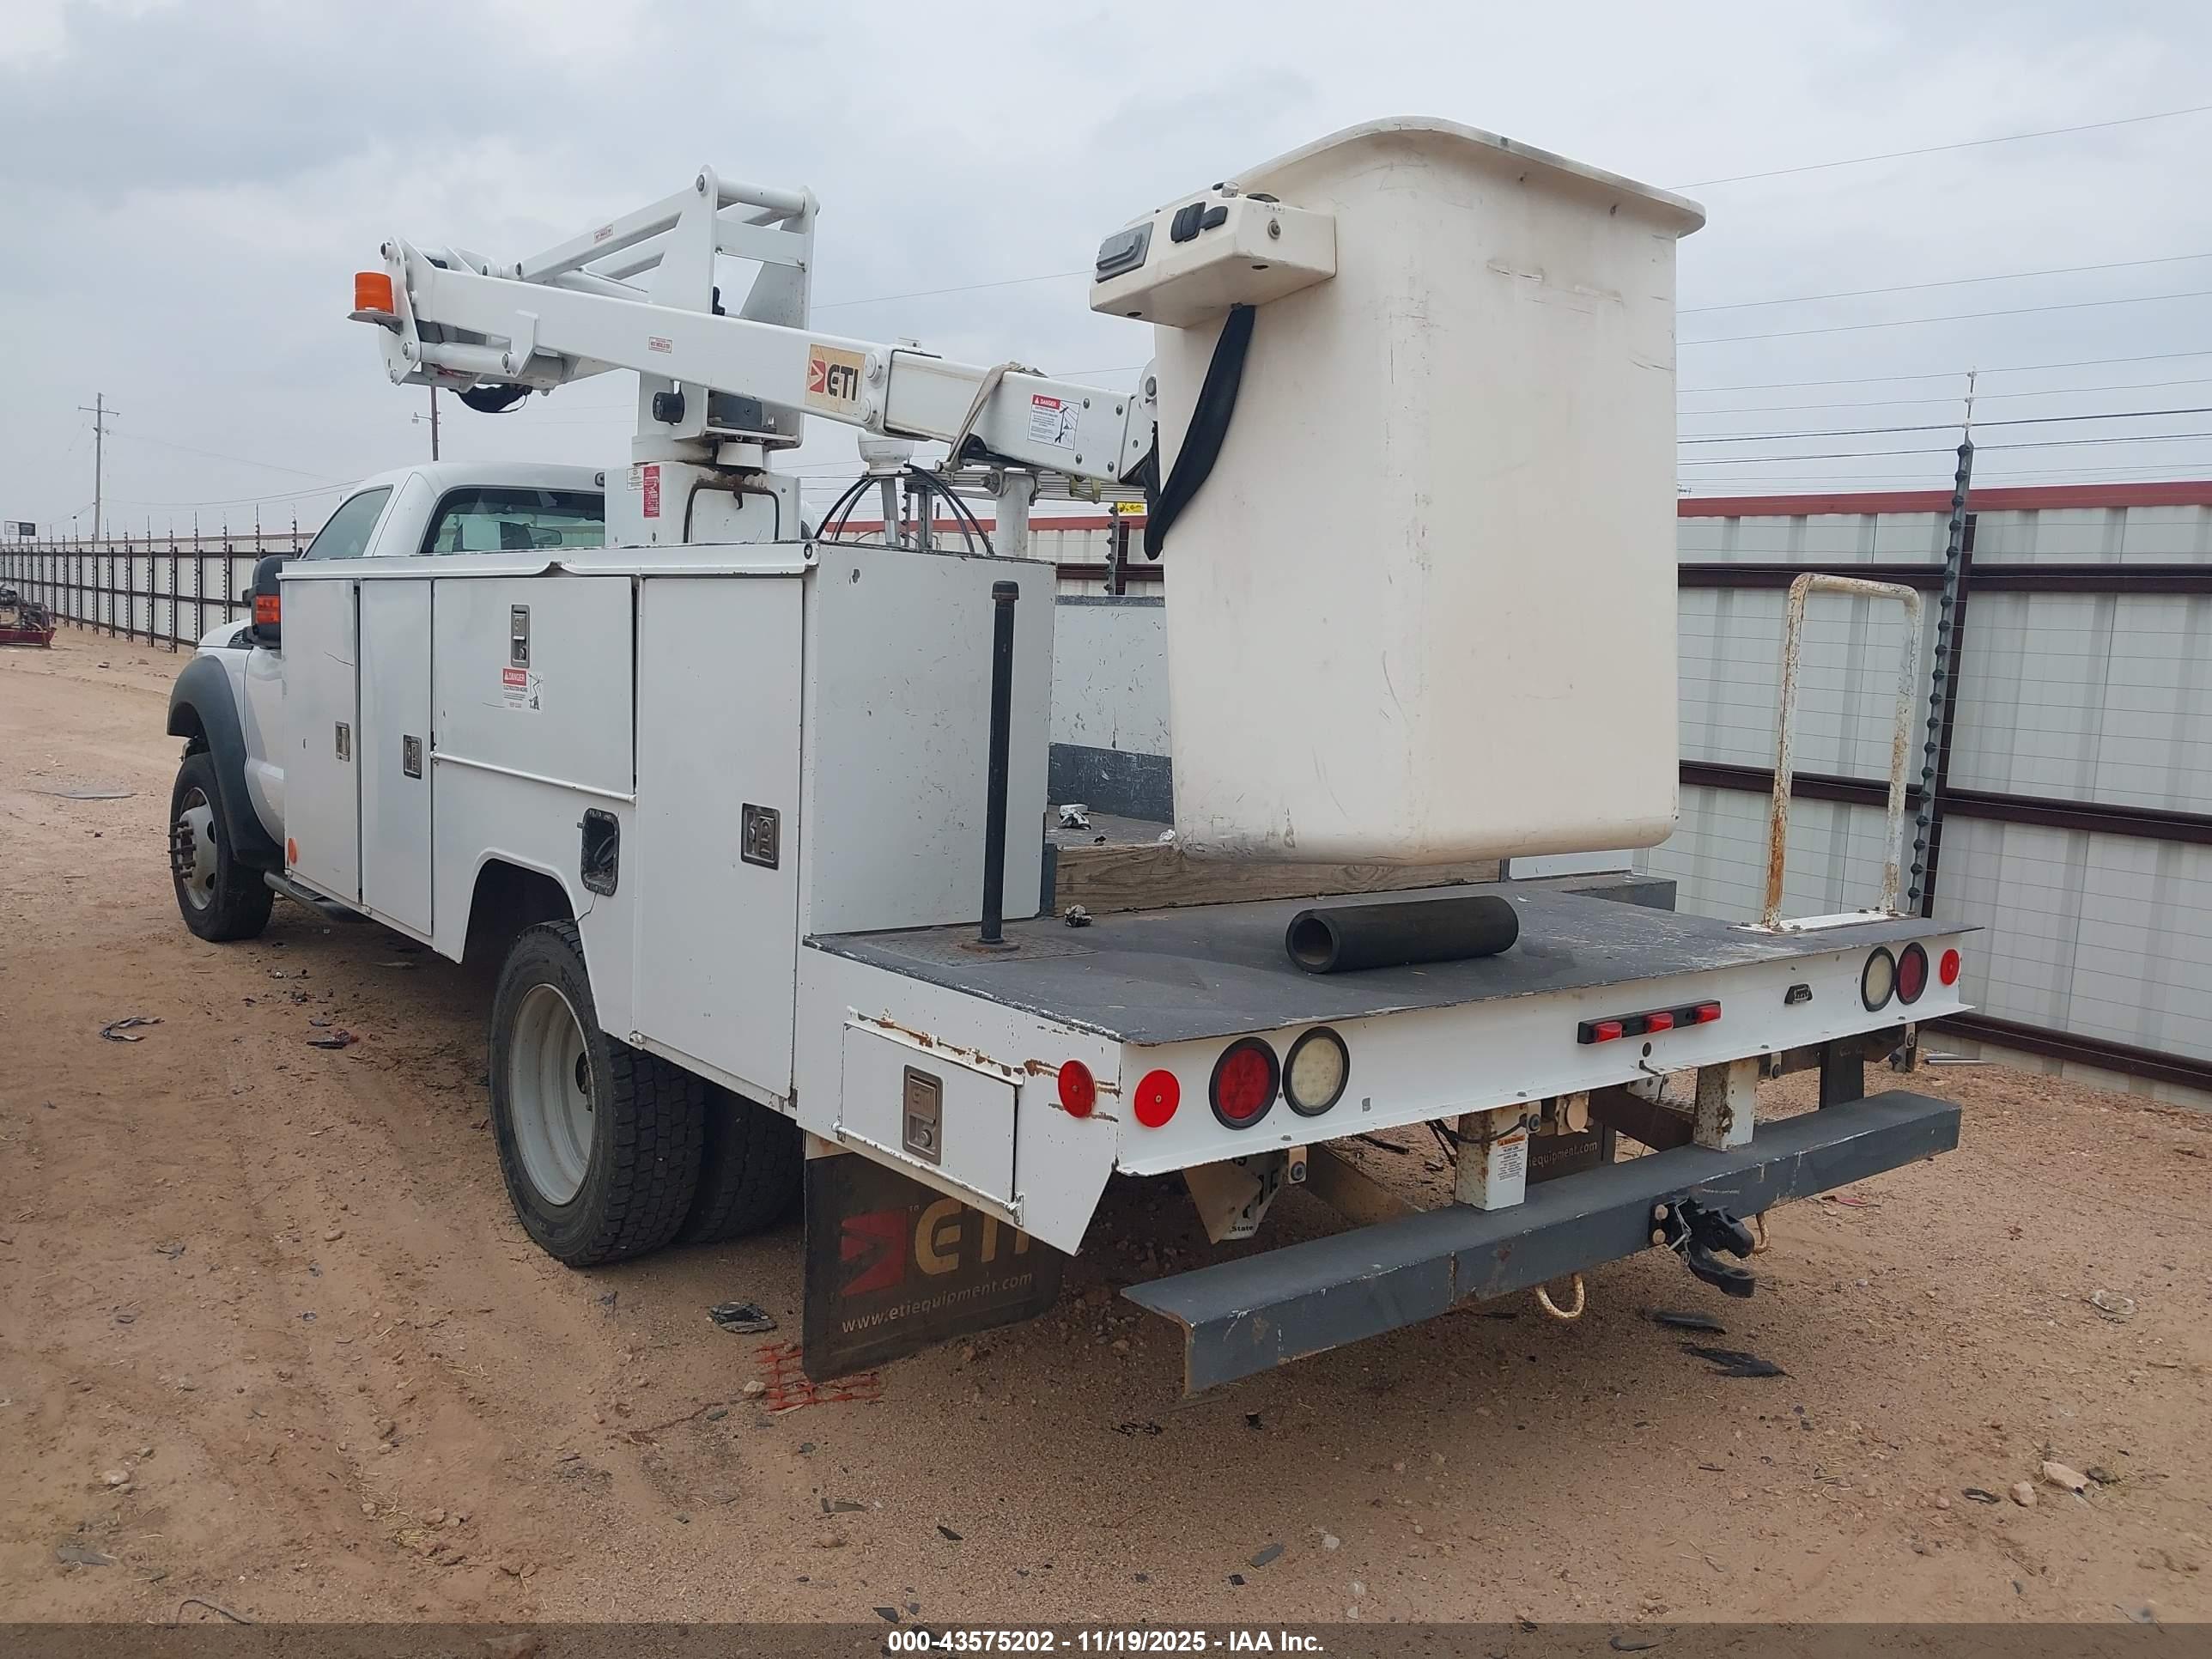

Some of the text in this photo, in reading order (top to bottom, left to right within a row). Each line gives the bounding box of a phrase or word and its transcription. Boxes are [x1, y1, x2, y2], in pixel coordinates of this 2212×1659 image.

[826, 363, 859, 402] ETI
[1039, 398, 1058, 408] DANGER
[507, 672, 526, 683] DANGER
[842, 1272, 1033, 1333] www.etiequipment.com
